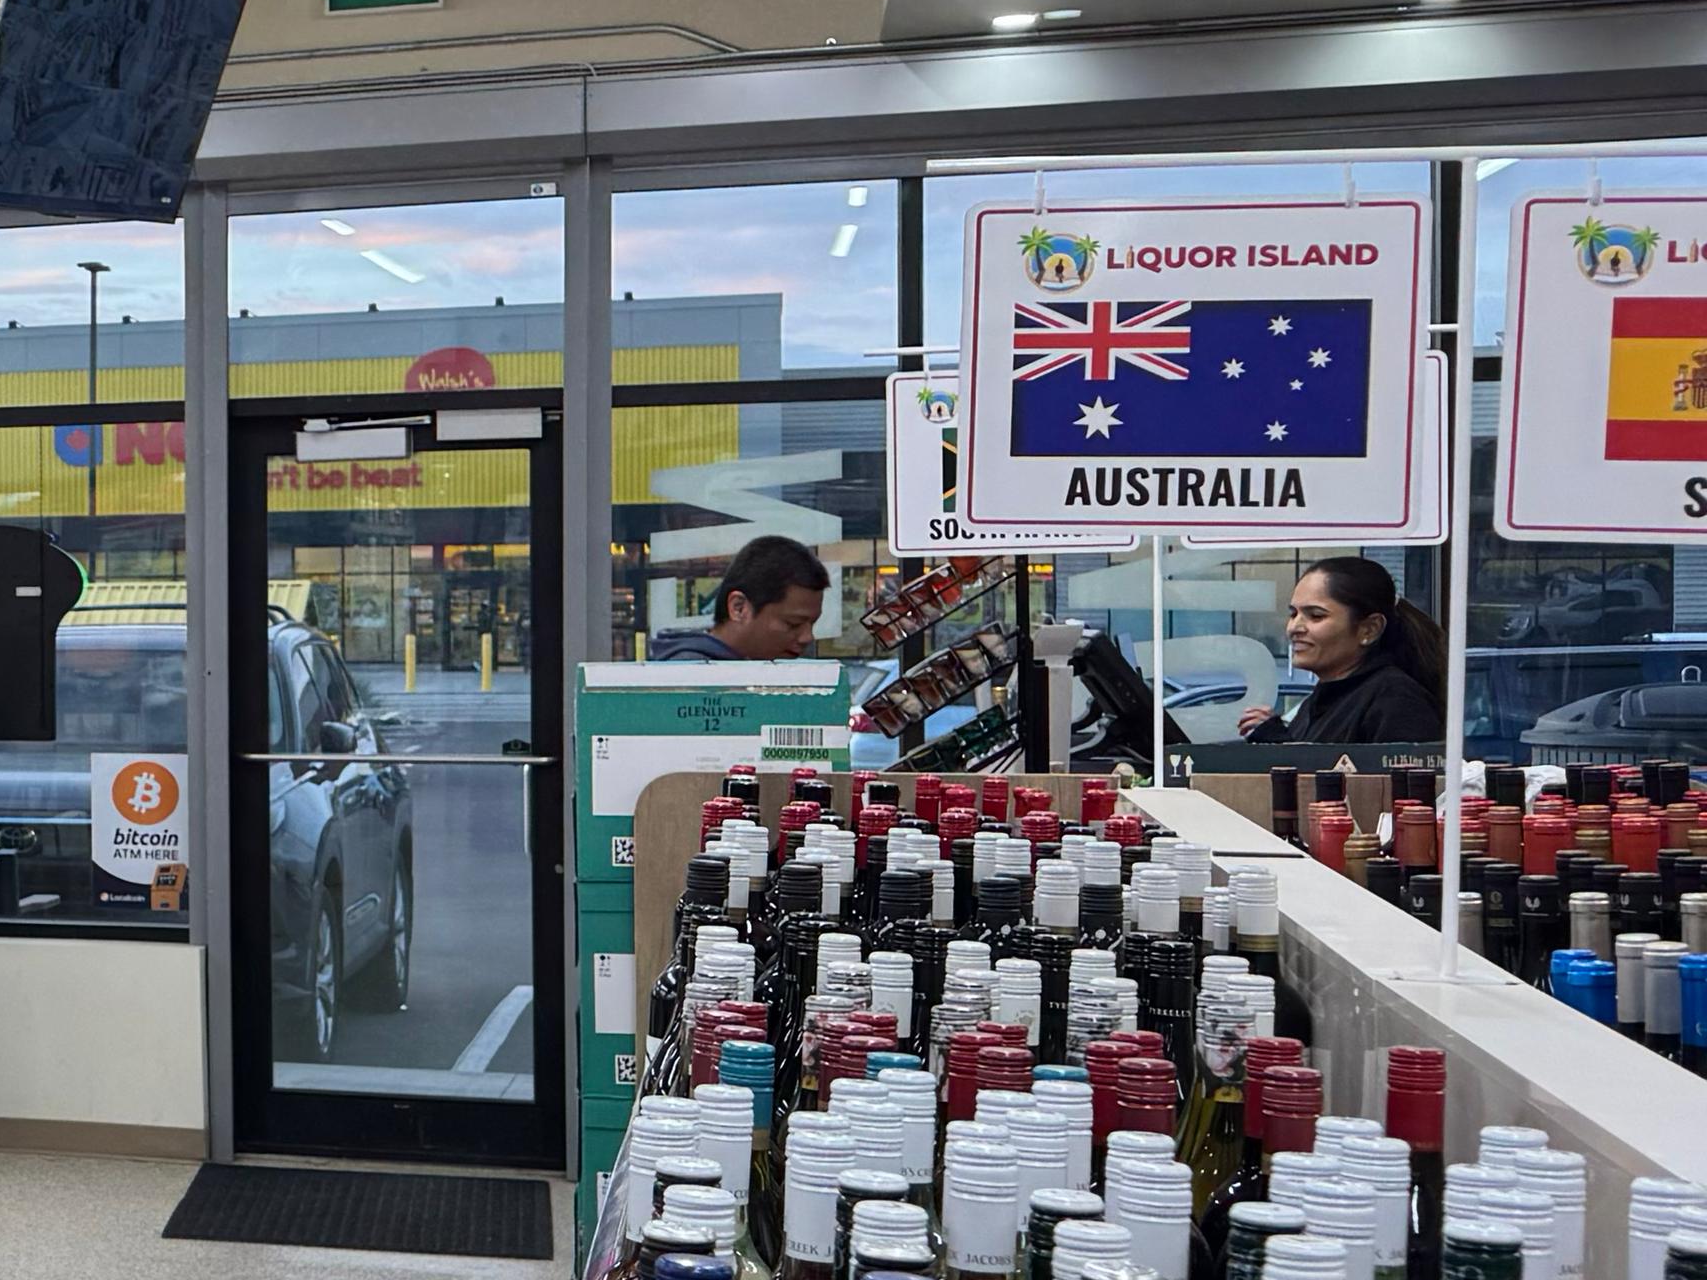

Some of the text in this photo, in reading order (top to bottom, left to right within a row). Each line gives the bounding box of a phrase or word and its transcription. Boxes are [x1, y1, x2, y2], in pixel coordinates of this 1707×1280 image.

[1107, 244, 1378, 273] LIQUOR ISLAND
[307, 463, 423, 489] be beat
[1065, 466, 1307, 509] AUSTRALIA
[677, 706, 747, 719] GLENLIVET
[703, 719, 721, 732] 12
[113, 828, 179, 847] bitcoin
[113, 849, 179, 861] ATM HERE
